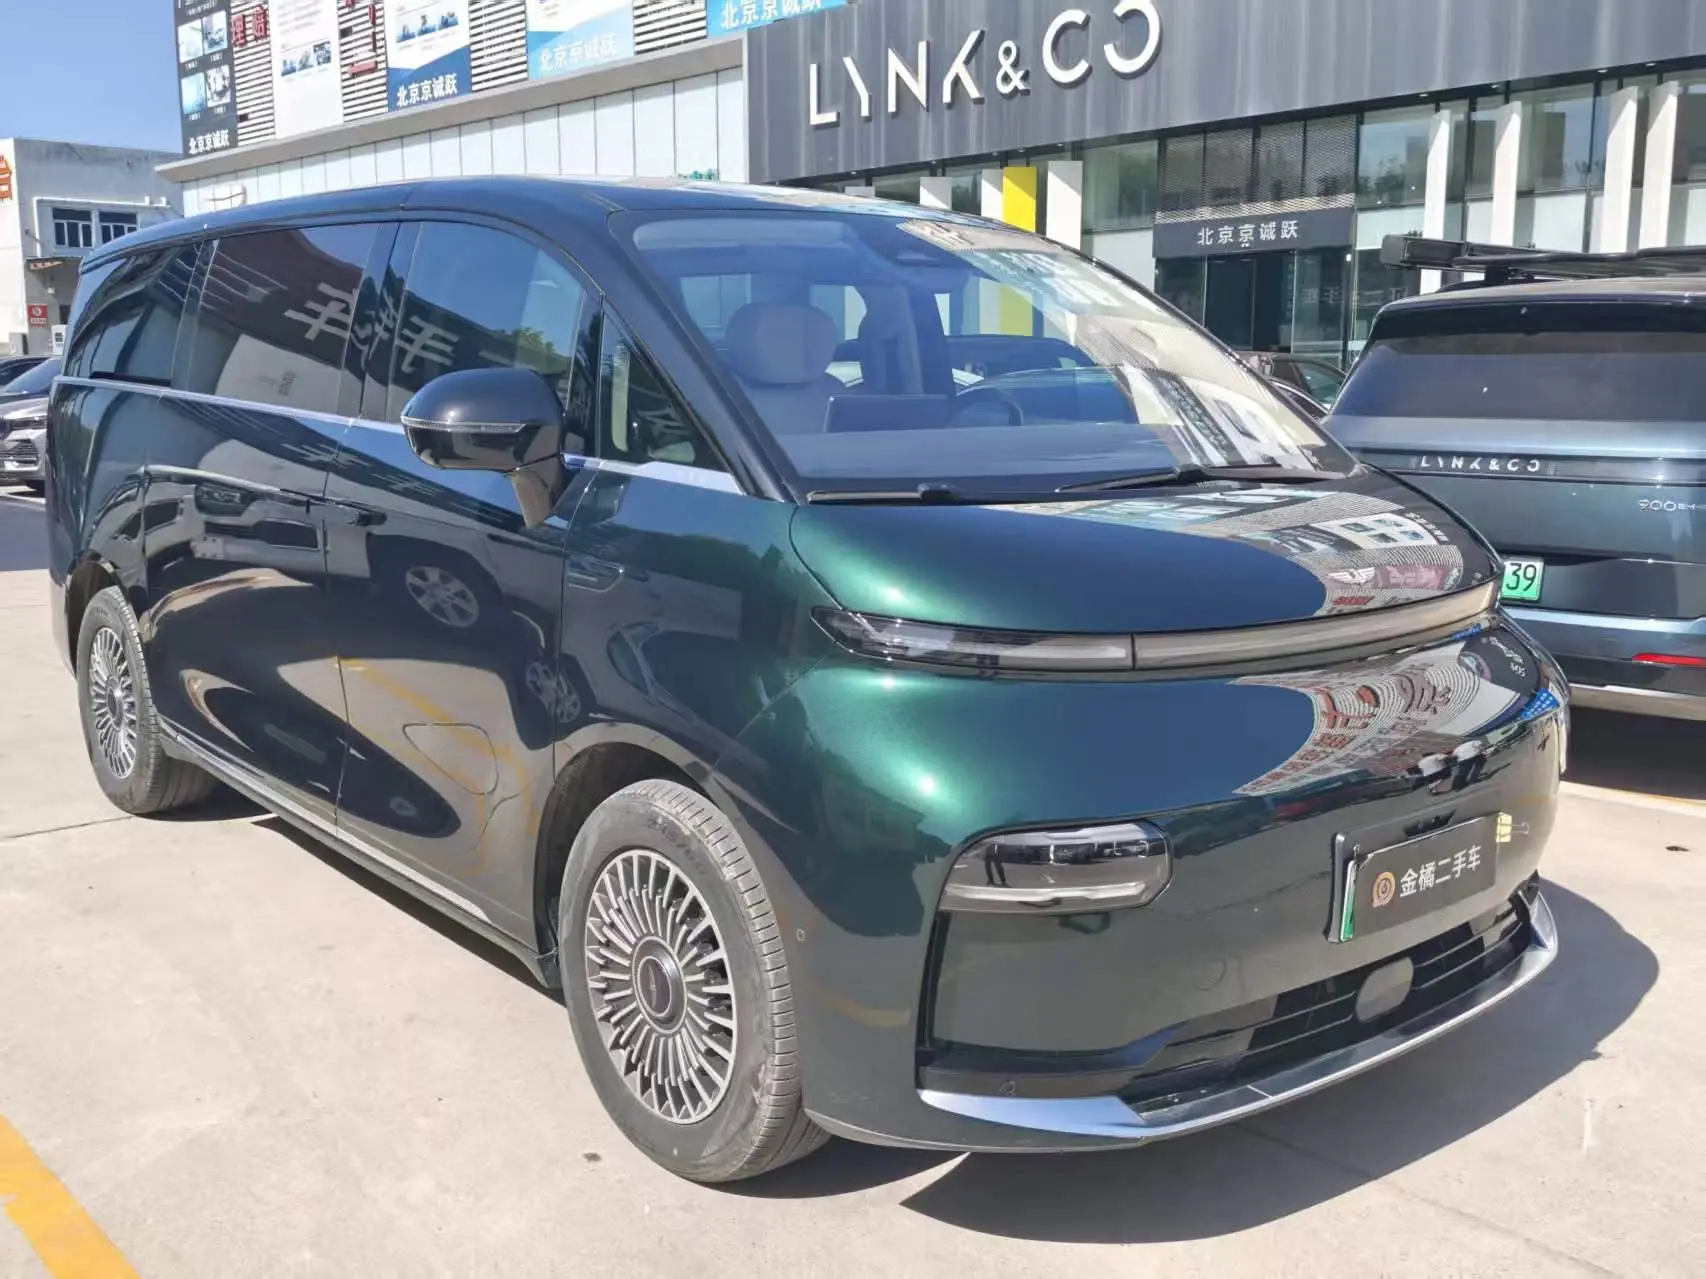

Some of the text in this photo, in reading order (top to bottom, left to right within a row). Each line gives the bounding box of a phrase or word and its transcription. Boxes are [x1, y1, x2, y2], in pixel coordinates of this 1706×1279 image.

[539, 32, 618, 71] 北京京诚跃
[396, 73, 458, 107] 北京京诚跃
[1197, 219, 1299, 245] 北京京诚跃
[1420, 455, 1540, 472] LYNK&CO
[1506, 563, 1537, 592] 39
[1399, 844, 1482, 897] 金橘二手车
